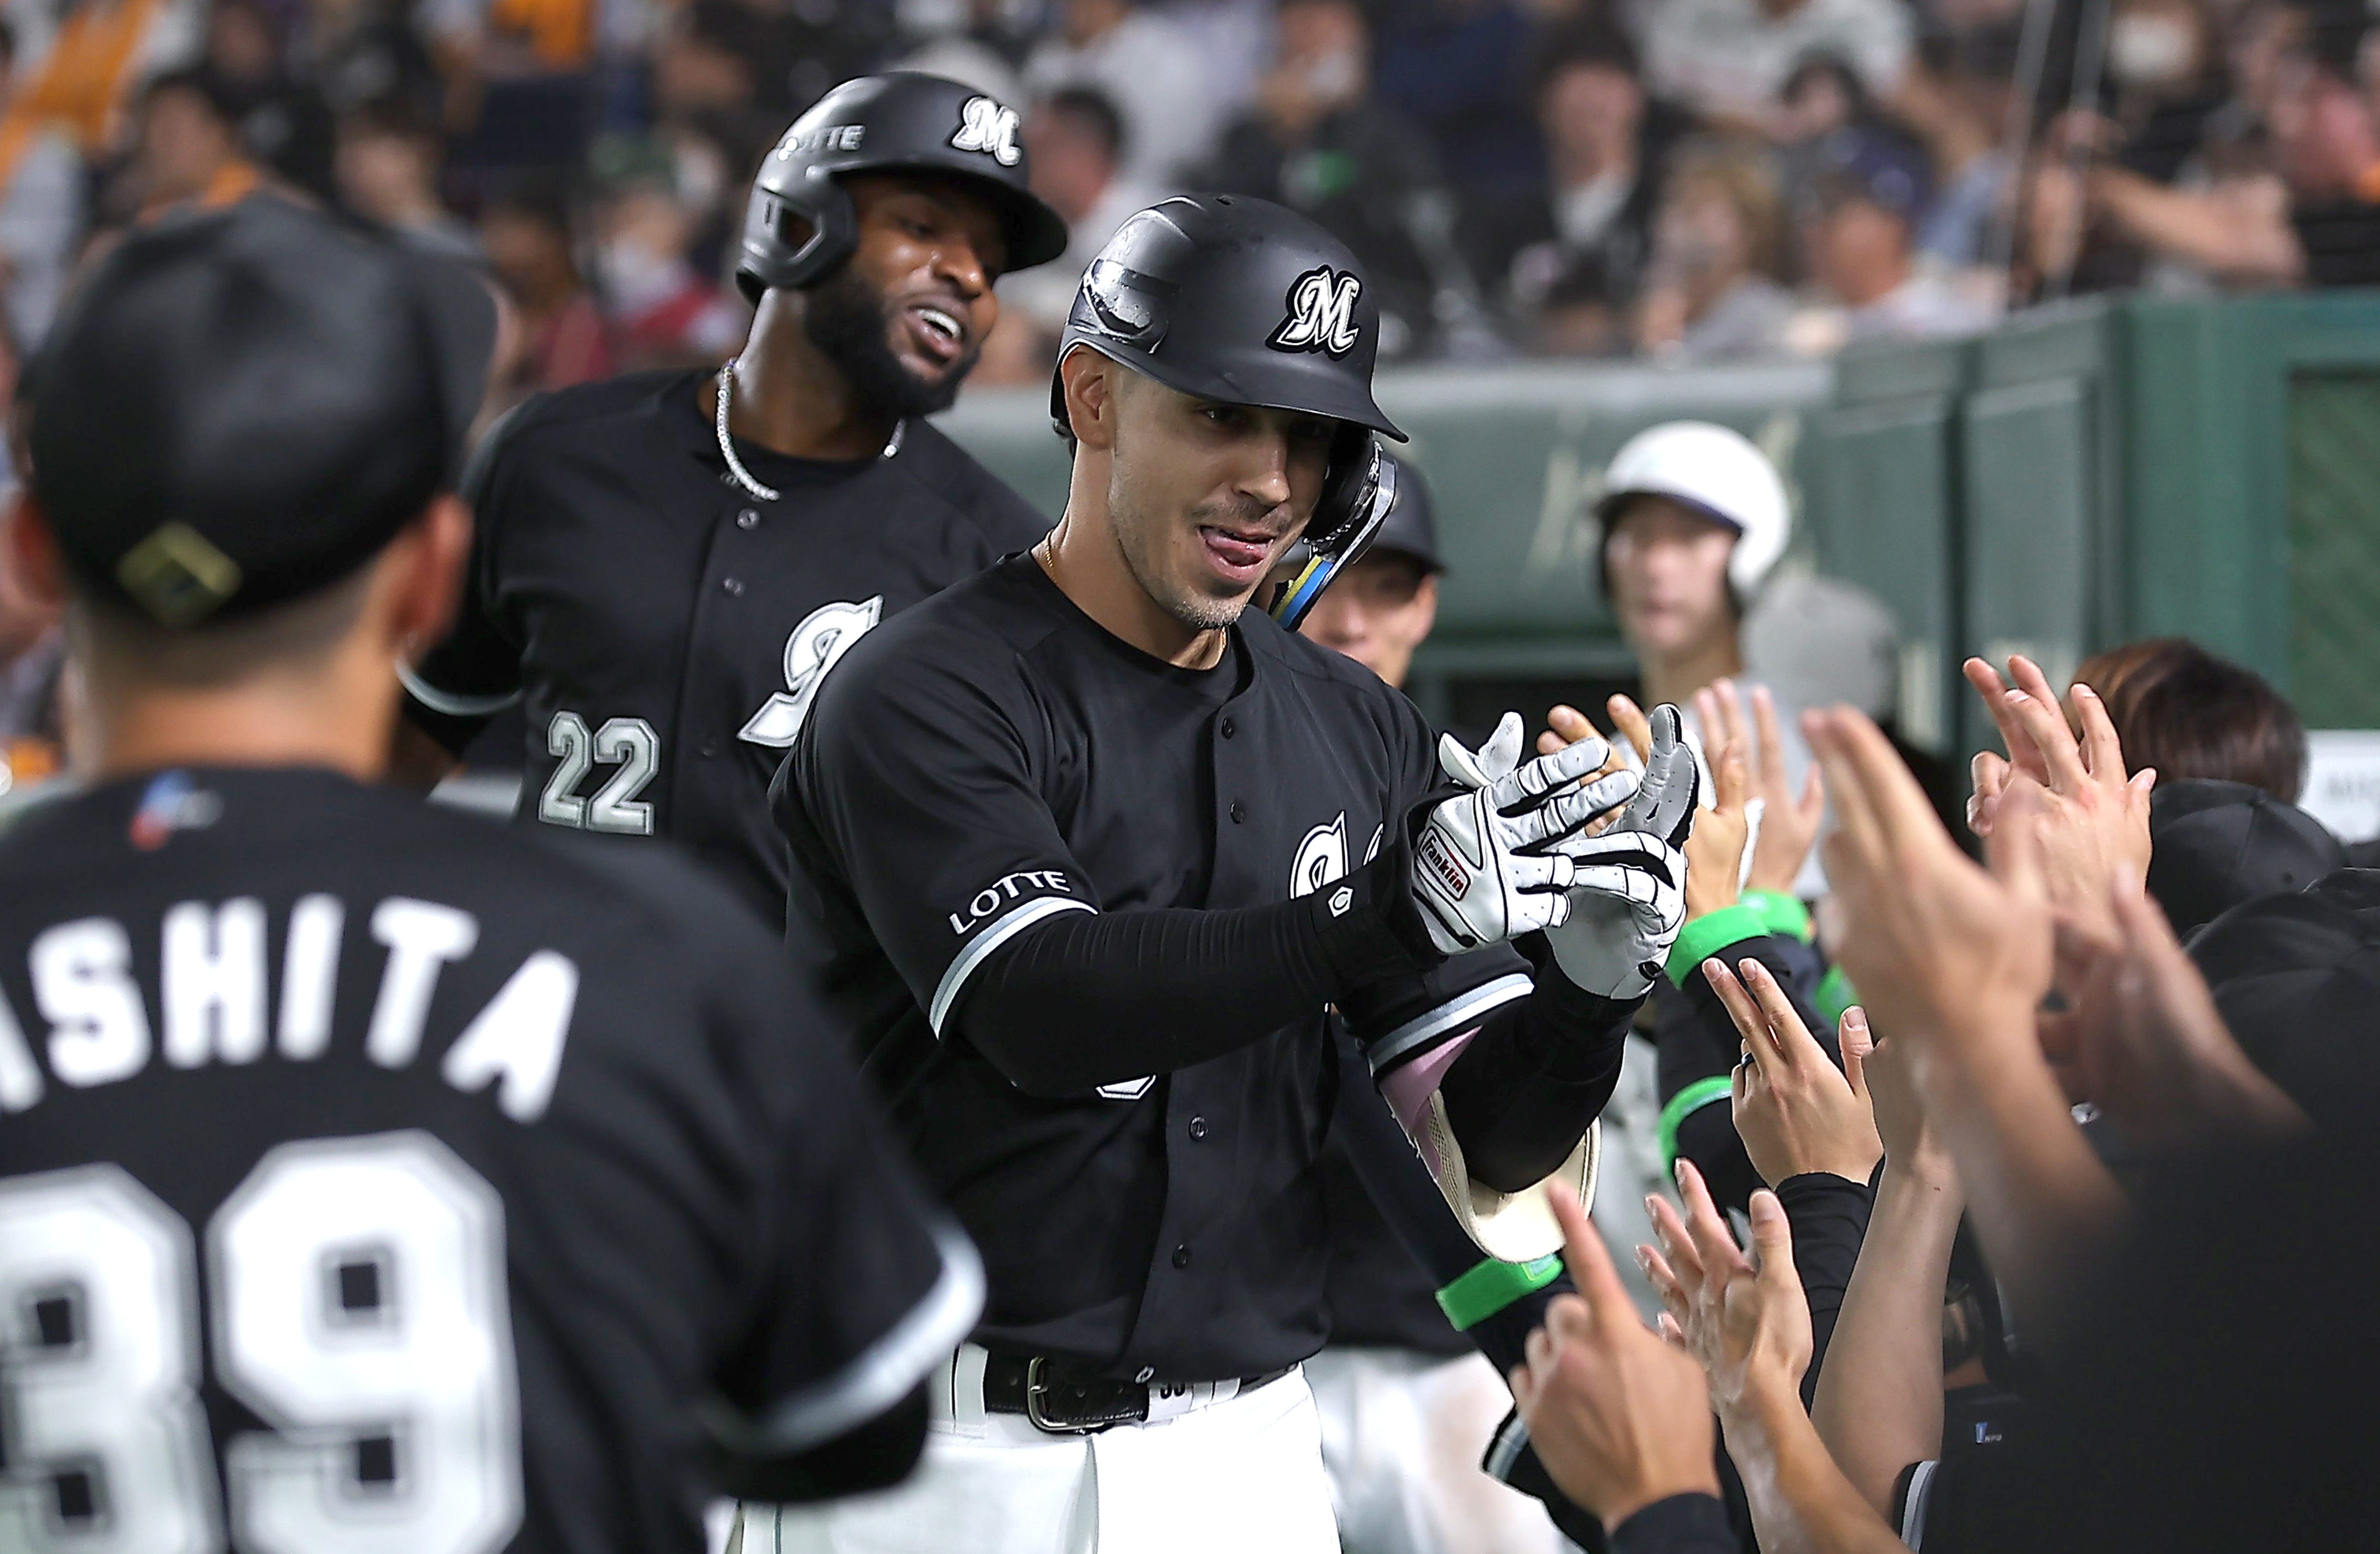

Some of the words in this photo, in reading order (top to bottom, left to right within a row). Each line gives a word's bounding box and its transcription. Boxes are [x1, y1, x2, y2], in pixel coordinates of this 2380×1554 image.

[778, 125, 866, 161] TTE
[952, 96, 1022, 166] M
[1276, 269, 1360, 354] M
[538, 710, 661, 836] 22
[1421, 835, 1464, 893] Franklin
[949, 870, 1071, 935] LOTTE
